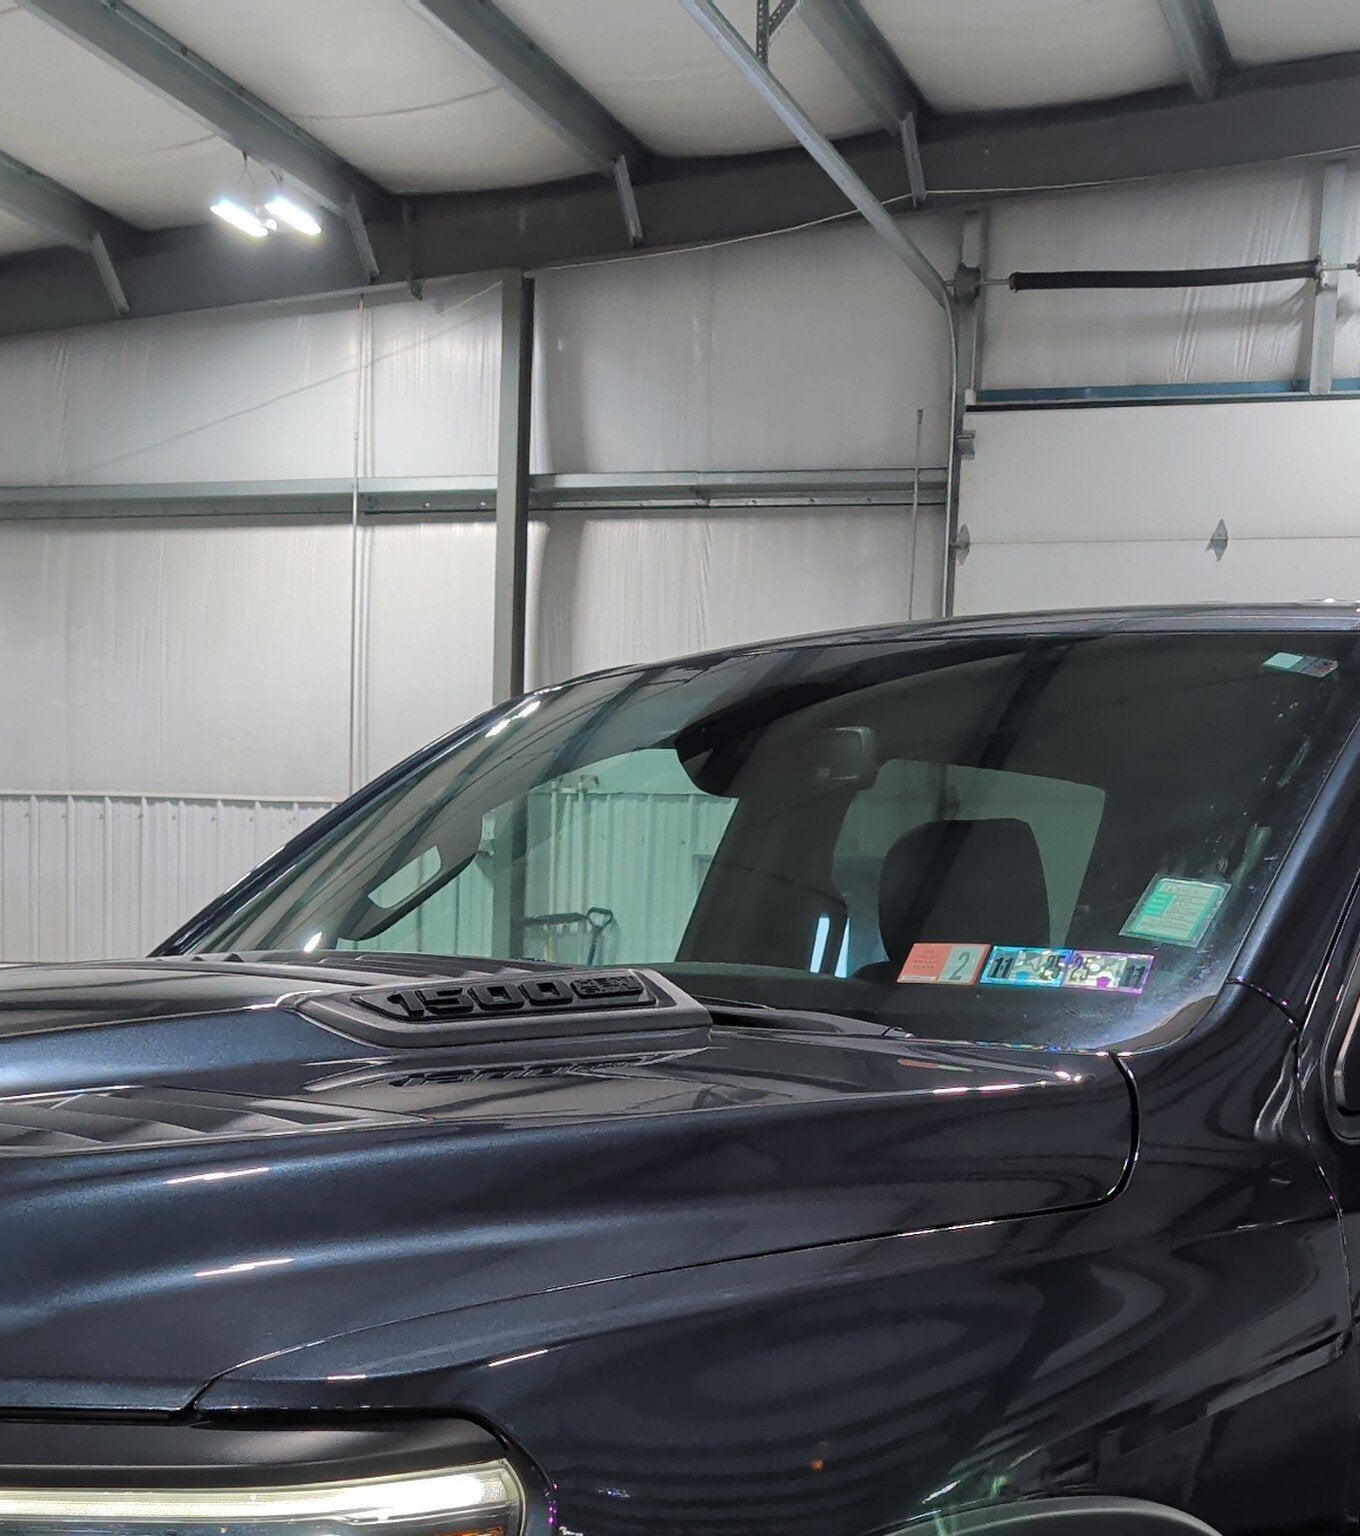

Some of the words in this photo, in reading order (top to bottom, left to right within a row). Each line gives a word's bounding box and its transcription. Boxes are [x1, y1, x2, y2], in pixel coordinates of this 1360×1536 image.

[949, 951, 971, 980] 2
[991, 956, 1015, 979] 11
[386, 978, 574, 1018] 1500
